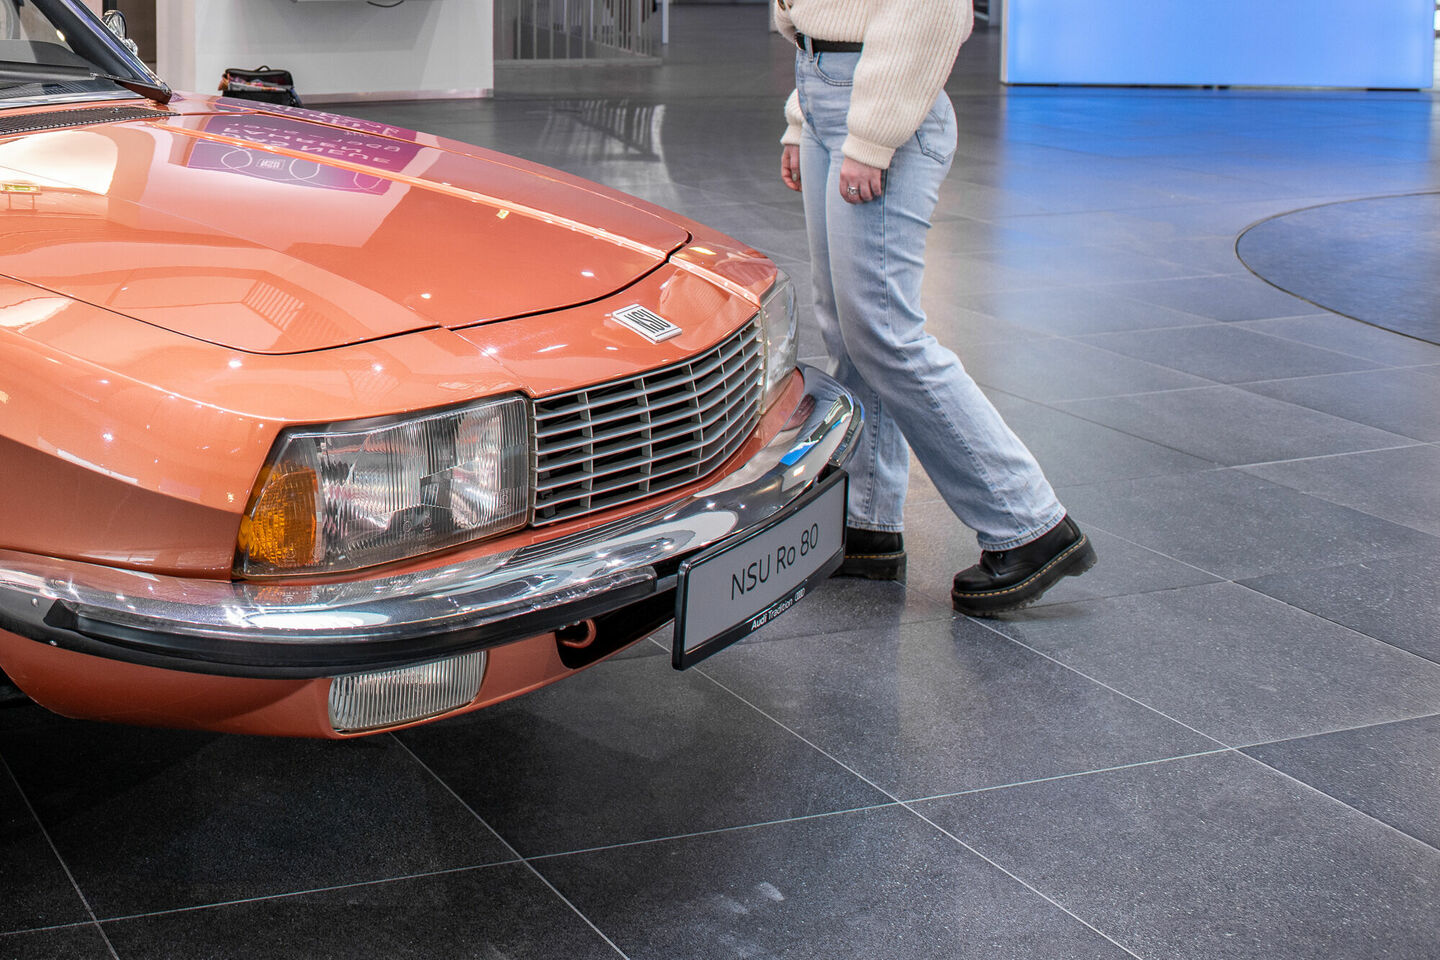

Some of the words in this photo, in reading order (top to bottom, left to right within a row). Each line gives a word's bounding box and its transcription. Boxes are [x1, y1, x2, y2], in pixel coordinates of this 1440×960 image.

[623, 308, 672, 334] NSU
[731, 553, 771, 601] NSU
[776, 545, 796, 575] Ro
[800, 522, 819, 557] 80
[750, 613, 768, 632] Audi
[768, 598, 793, 621] Tradition
